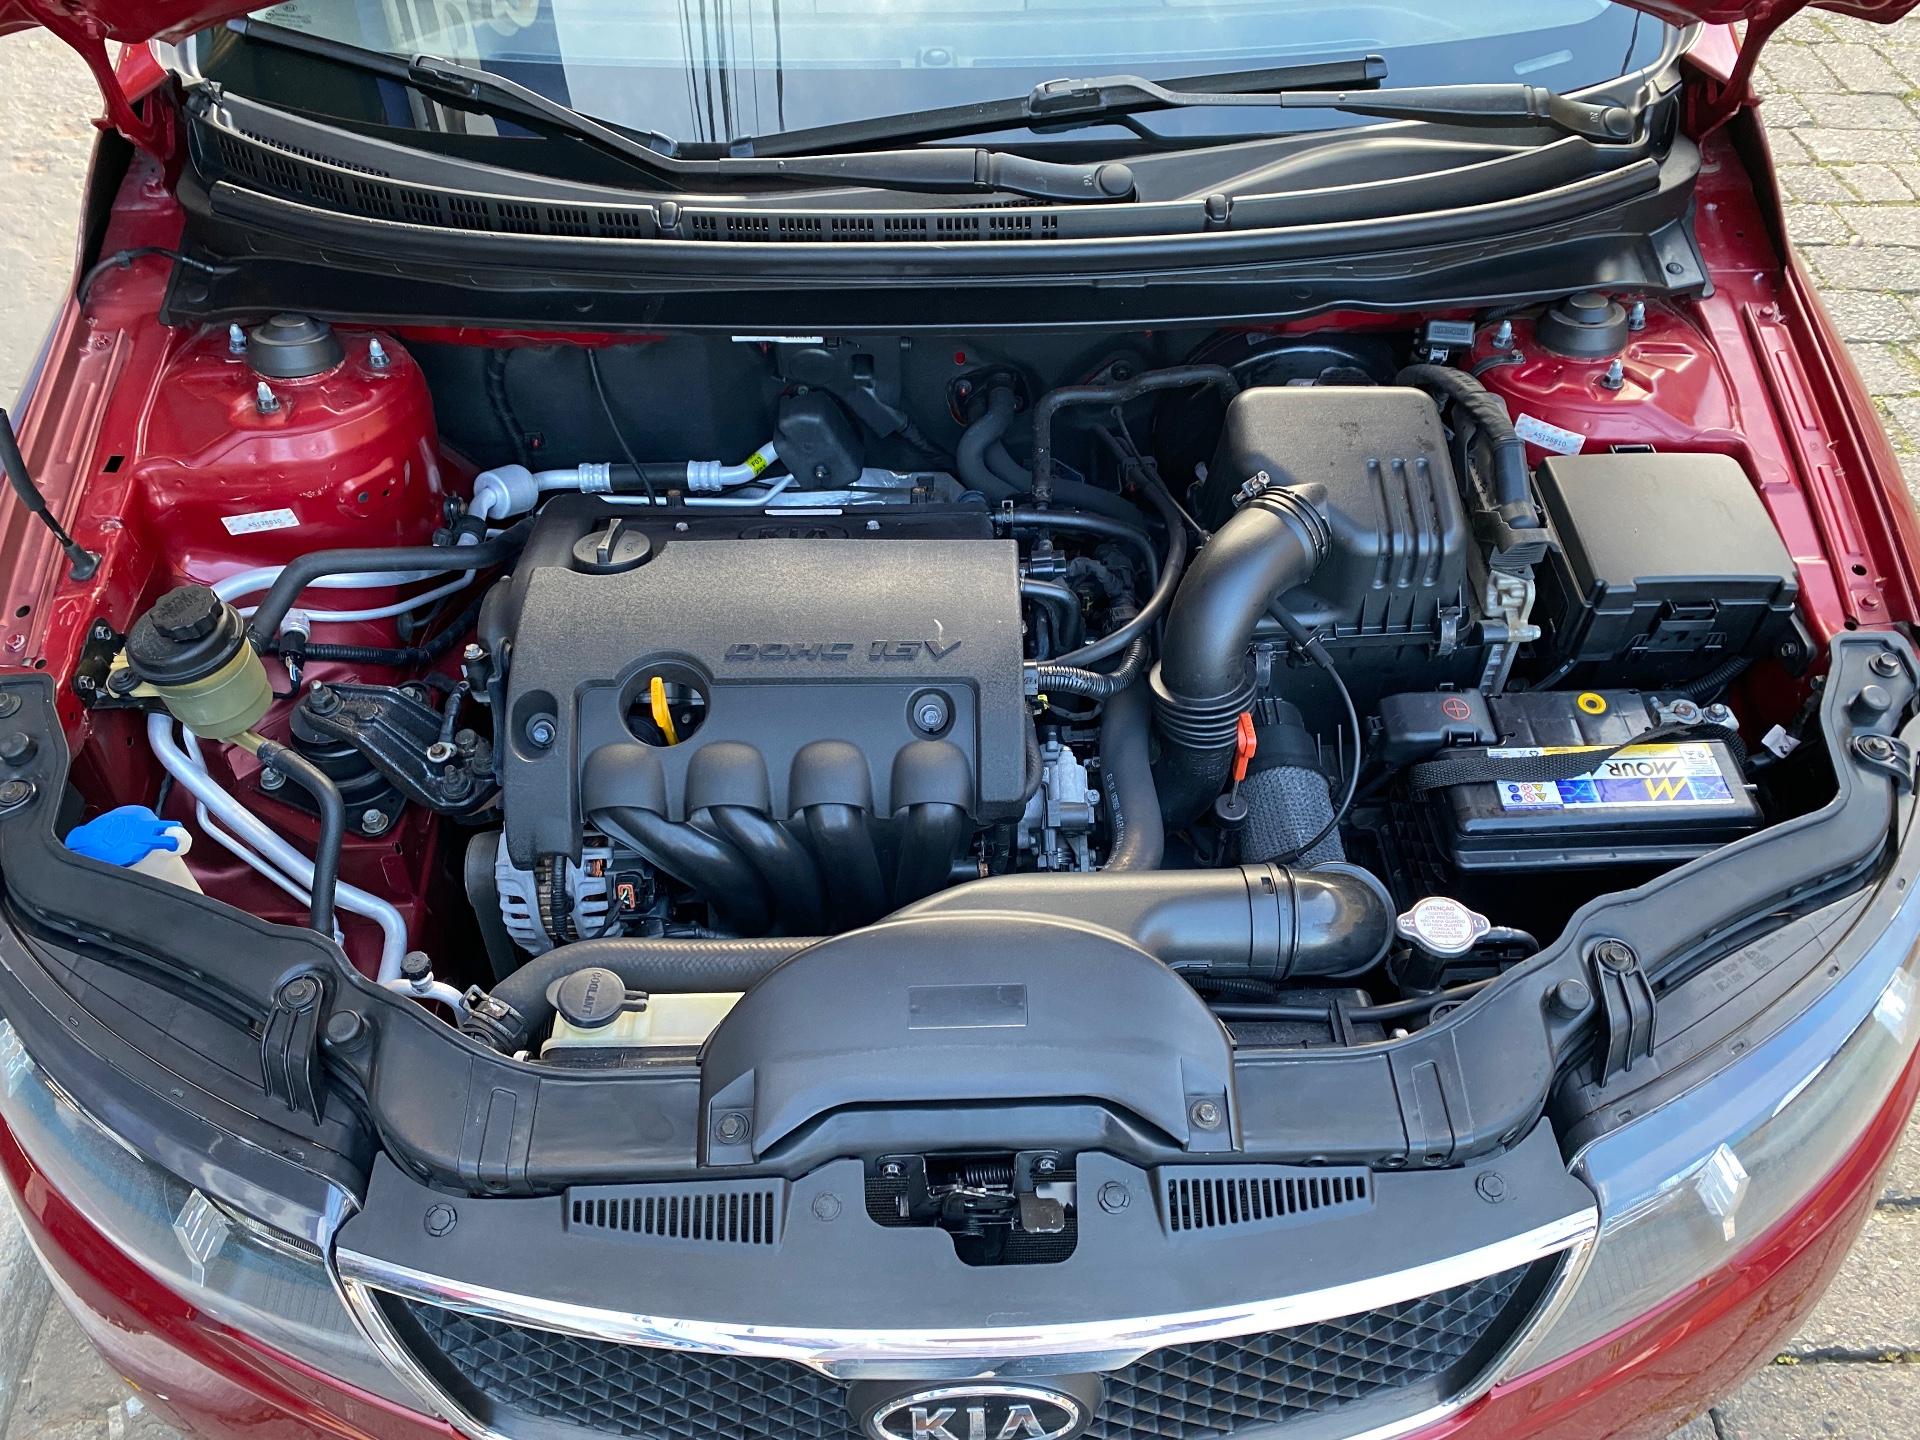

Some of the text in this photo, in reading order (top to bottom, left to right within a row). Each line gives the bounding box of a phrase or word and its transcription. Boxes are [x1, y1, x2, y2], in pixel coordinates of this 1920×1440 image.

[723, 643, 854, 660] DOHC
[869, 640, 962, 660] 16V
[582, 971, 602, 1016] COOLANT
[909, 1405, 1046, 1440] KIA
